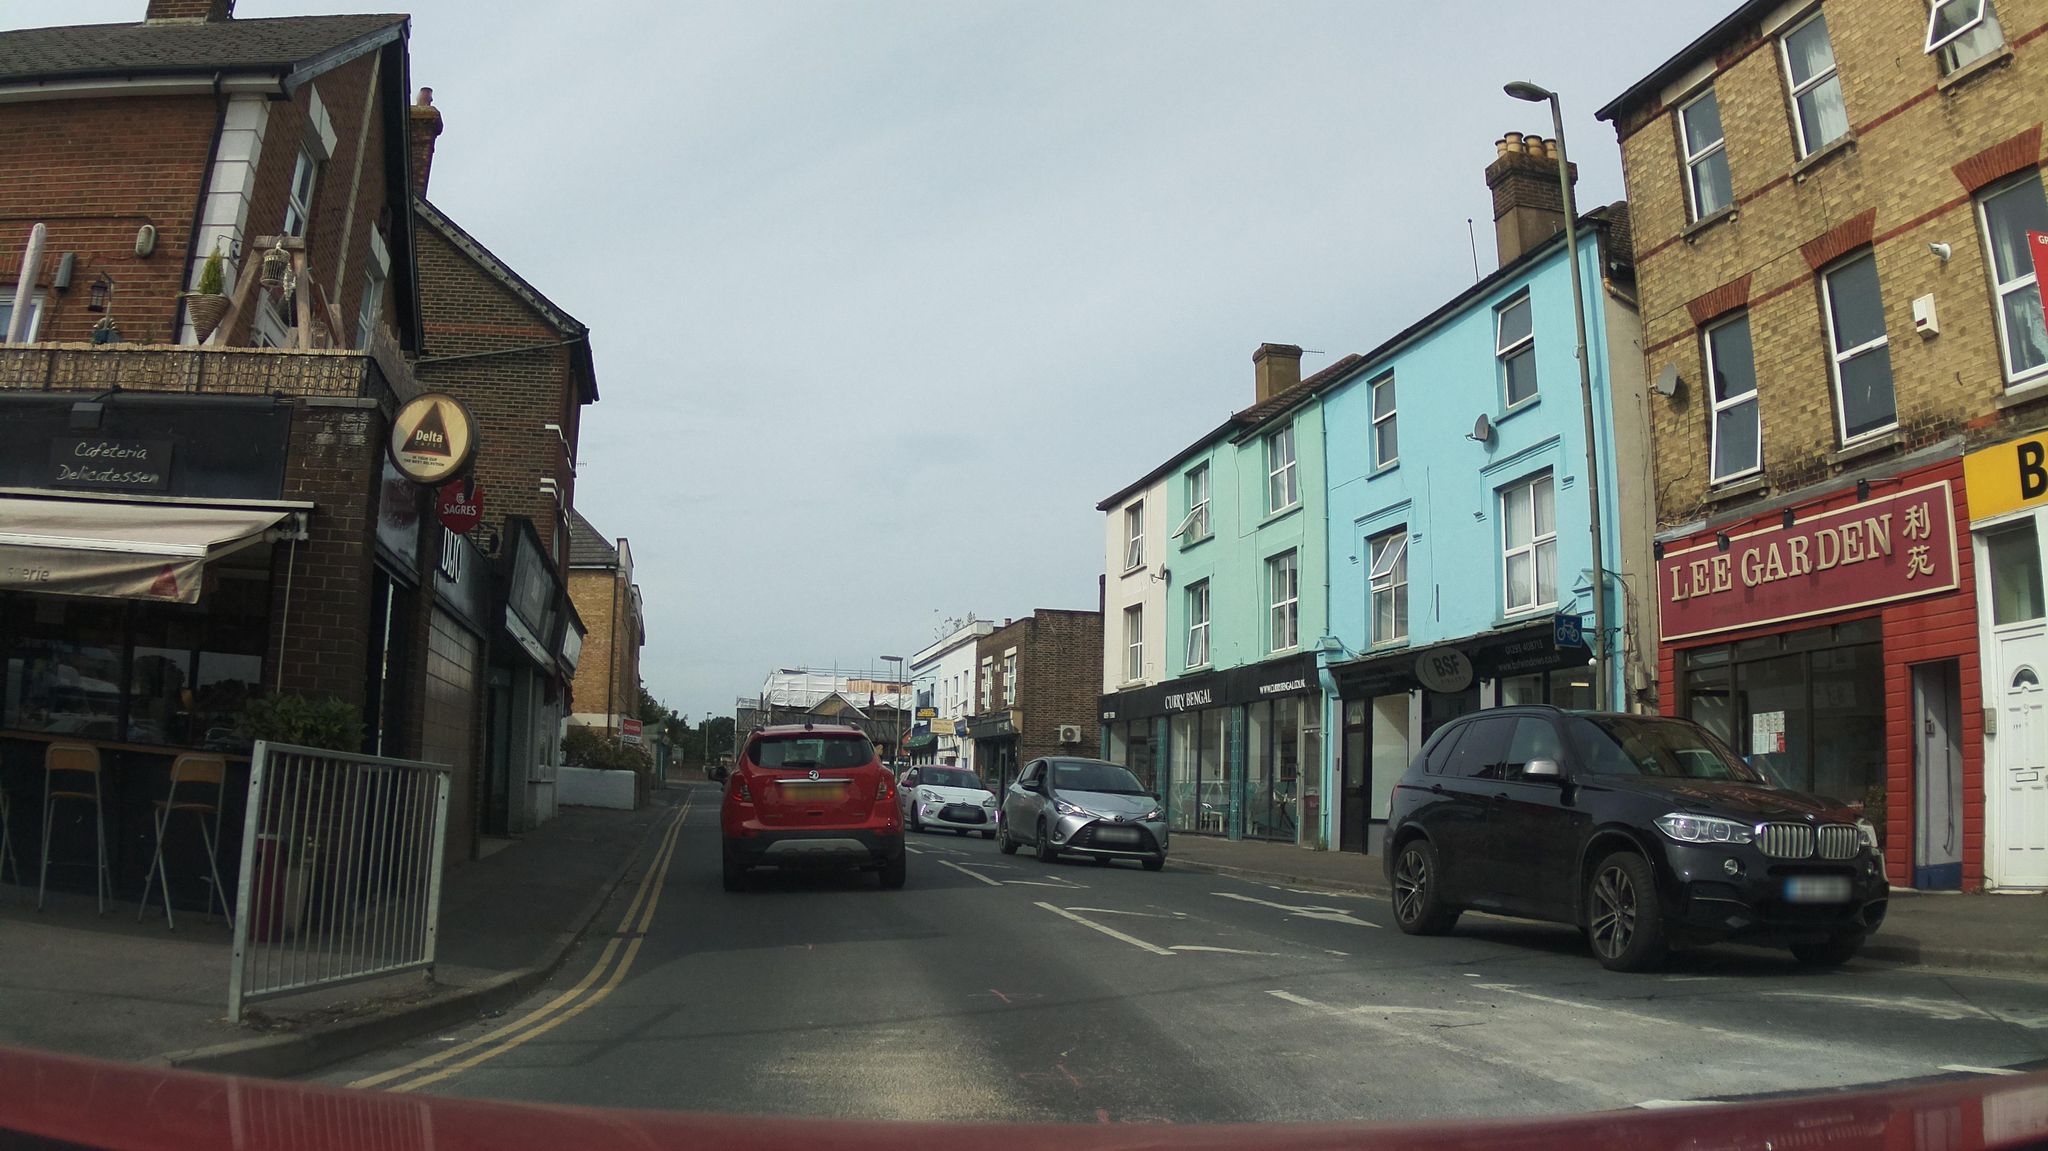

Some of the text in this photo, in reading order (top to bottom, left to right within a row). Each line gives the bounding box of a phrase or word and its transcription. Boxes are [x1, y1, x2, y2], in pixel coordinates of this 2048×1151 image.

[415, 430, 443, 443] Delta
[74, 442, 147, 460] Cafeteria
[56, 464, 160, 483] Delicatessen
[443, 503, 477, 516] SAGRES
[1670, 513, 1893, 602] LEE GARDEN
[1432, 654, 1460, 677] BSF
[1164, 688, 1212, 712] CURRY BENGAL
